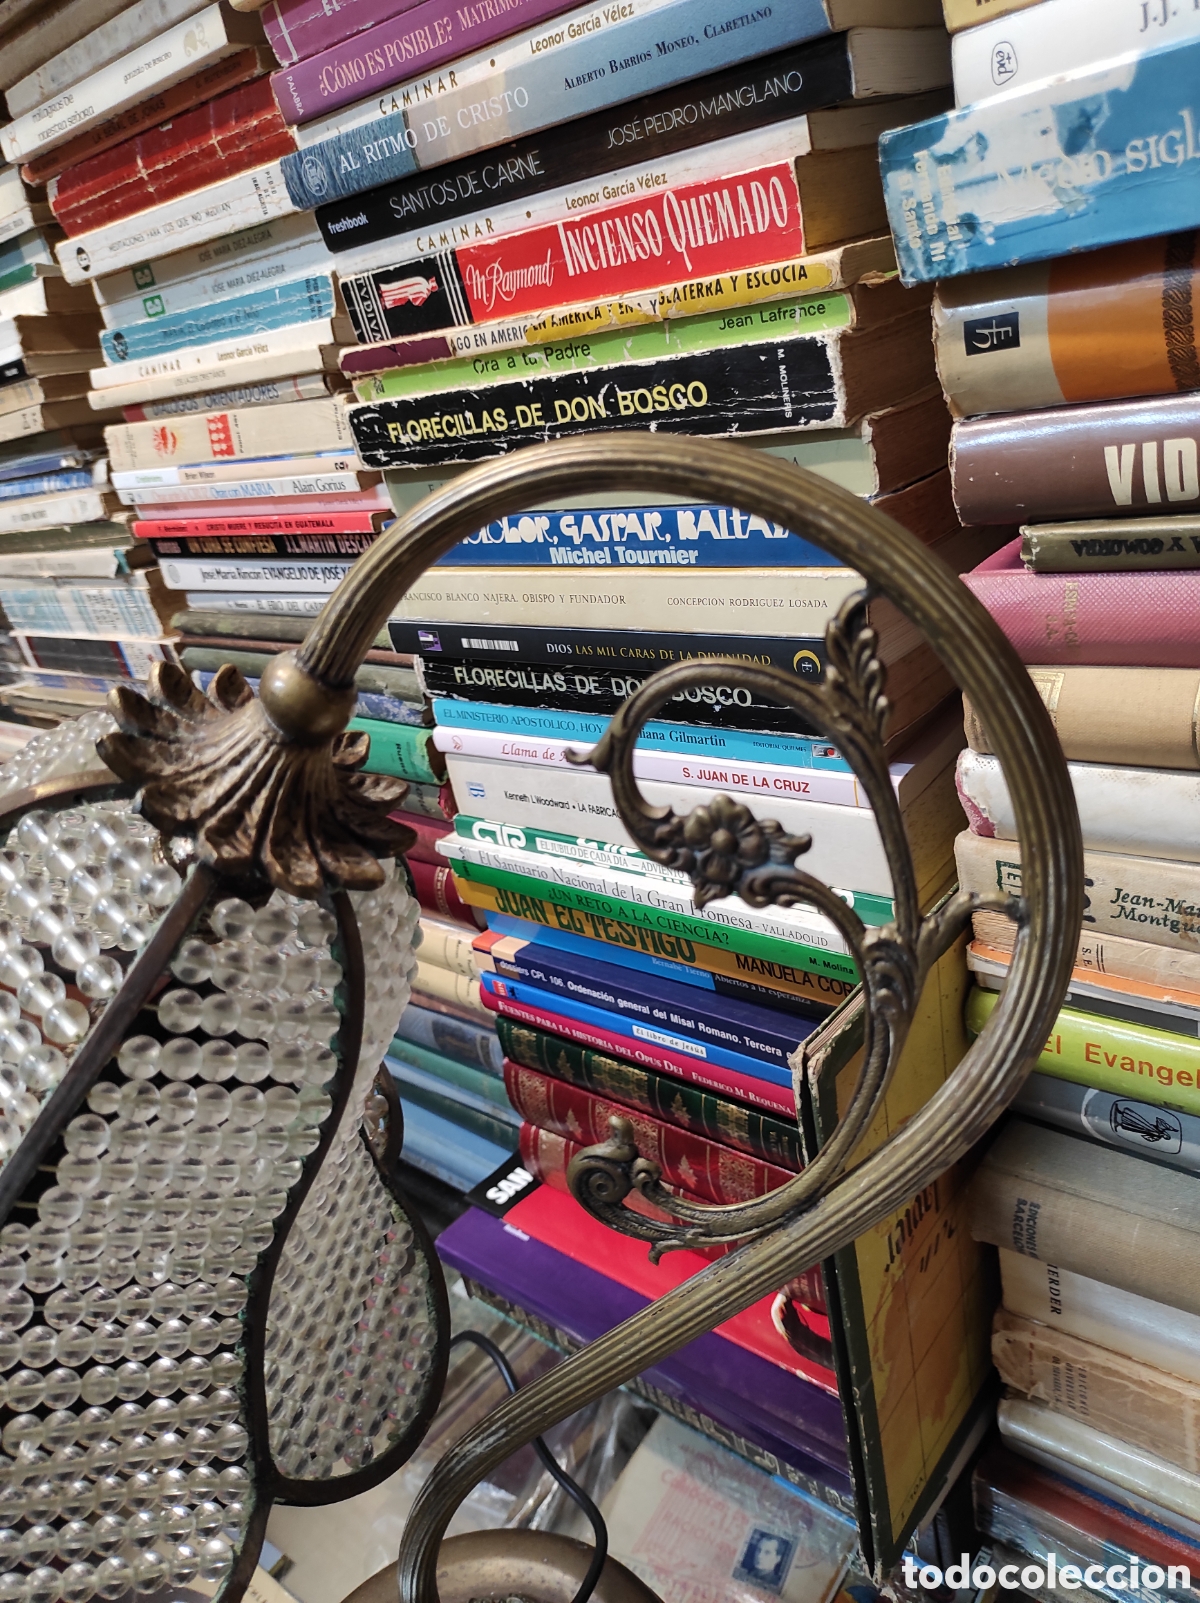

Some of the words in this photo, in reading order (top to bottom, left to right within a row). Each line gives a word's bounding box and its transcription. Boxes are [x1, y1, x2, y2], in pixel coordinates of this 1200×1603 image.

[529, 30, 565, 55] Leonor
[567, 12, 602, 39] García
[602, 1, 635, 23] Vélez
[319, 58, 366, 96] ¿CÓMO
[365, 47, 386, 76] ES
[386, 16, 453, 69] POSIBLE?
[563, 67, 606, 91] ALBERTO
[609, 49, 653, 75] BARRIOS
[655, 34, 700, 57] MONEO,
[703, 6, 772, 40] CLARETIANO
[286, 75, 305, 116] PALABRA
[379, 70, 459, 116] CAMINAR
[607, 115, 645, 149] JOSÉ
[644, 103, 699, 137] PEDRO
[699, 70, 803, 120] MANGLANO
[339, 151, 362, 174] AL
[362, 128, 418, 165] RITMO
[423, 115, 449, 142] DE
[456, 86, 530, 130] CRISTO
[389, 179, 457, 219] SANTOS
[456, 170, 484, 199] DE
[482, 150, 546, 190] CARNE
[565, 191, 600, 210] Leonor
[602, 177, 636, 201] García
[636, 171, 668, 190] Vélez
[328, 212, 369, 235] freshbook
[416, 217, 495, 253] CAMINAR
[556, 208, 663, 278] INCIENSO
[663, 175, 788, 273] QUEMADO
[730, 275, 739, 293] Y
[746, 263, 809, 290] ESCOCIA
[719, 314, 754, 331] Jean
[759, 302, 827, 325] Lafrance
[474, 332, 488, 348] EN
[472, 357, 500, 375] Ora
[506, 356, 518, 370] a
[545, 342, 592, 363] Padre
[778, 364, 793, 420] MOLINERIS
[386, 407, 509, 445] FLORECILLAS
[515, 404, 546, 429] DE
[554, 395, 607, 425] DON
[240, 481, 276, 498] MARIA
[292, 480, 317, 494] Alain
[560, 511, 671, 545] GASPAR,
[548, 546, 613, 566] Michel
[613, 546, 699, 566] Tournier
[262, 566, 308, 581] EVANGELIO
[308, 568, 321, 580] DE
[445, 592, 481, 603] BLANCO
[522, 592, 556, 605] OBISPO
[558, 594, 566, 605] Y
[569, 593, 627, 605] FUNDADOR
[667, 597, 725, 608] CONCEPCION
[729, 598, 785, 609] RODRIGUEZ
[788, 599, 829, 609] LOSADA
[546, 643, 573, 655] DIOS
[575, 644, 594, 656] LAS
[596, 645, 618, 657] MIL
[619, 646, 656, 660] CARAS
[659, 648, 676, 661] DE
[679, 650, 693, 662] LA
[453, 666, 568, 693] FLORECILLAS
[574, 674, 602, 695] DE
[443, 708, 458, 718] EL
[457, 710, 509, 725] MINISTERIO
[510, 715, 579, 733] APOSTOLICO,
[580, 722, 603, 734] HOY
[501, 743, 539, 760] Llama
[542, 748, 556, 761] de
[668, 730, 727, 748] Gilmartin
[682, 766, 694, 780] S.
[696, 768, 728, 784] JUAN
[731, 773, 750, 786] DE
[752, 775, 770, 789] LA
[773, 778, 811, 795] CRUZ
[503, 790, 531, 804] Kenneth
[577, 801, 588, 813] LA
[540, 839, 551, 851] EL
[550, 841, 577, 857] JUBILO
[577, 847, 589, 859] DE
[589, 849, 611, 864] CADA
[611, 854, 629, 868] DIA
[479, 850, 492, 866] El
[494, 852, 549, 880] Santuario
[551, 866, 608, 895] Nacional
[611, 881, 628, 898] de
[631, 884, 643, 903] la
[647, 889, 685, 914] Gran
[761, 922, 829, 948] VALLADOLID
[494, 885, 550, 927] JUAN
[575, 891, 613, 914] RETO
[618, 905, 630, 920] A
[632, 908, 654, 926] LA
[655, 914, 730, 946] CIENCIA?
[683, 963, 712, 980] Tierno
[734, 952, 816, 990] MANUELA
[809, 955, 821, 967] M.
[822, 958, 855, 976] Molina
[714, 973, 749, 990] Abiertos
[757, 984, 768, 994] la
[499, 960, 530, 977] dossiers
[530, 968, 548, 983] CPL
[567, 980, 615, 1004] Ordenación
[617, 997, 651, 1016] general
[652, 1007, 668, 1021] del
[670, 1012, 696, 1030] Misal
[697, 1021, 743, 1045] Romano.
[743, 1036, 783, 1058] Tercera
[498, 1000, 537, 1023] FUENTES
[535, 1014, 558, 1031] PARA
[559, 1023, 571, 1037] LA
[572, 1028, 615, 1051] HISTORIA
[615, 1043, 636, 1059] DEL
[635, 1049, 663, 1069] OPUS
[663, 1058, 684, 1077] DEI
[691, 1070, 735, 1095] FEDERICO
[734, 1085, 748, 1100] M.
[635, 1027, 644, 1037] El
[645, 1030, 667, 1044] libro
[669, 1036, 681, 1047] de
[485, 1166, 535, 1206] SAN
